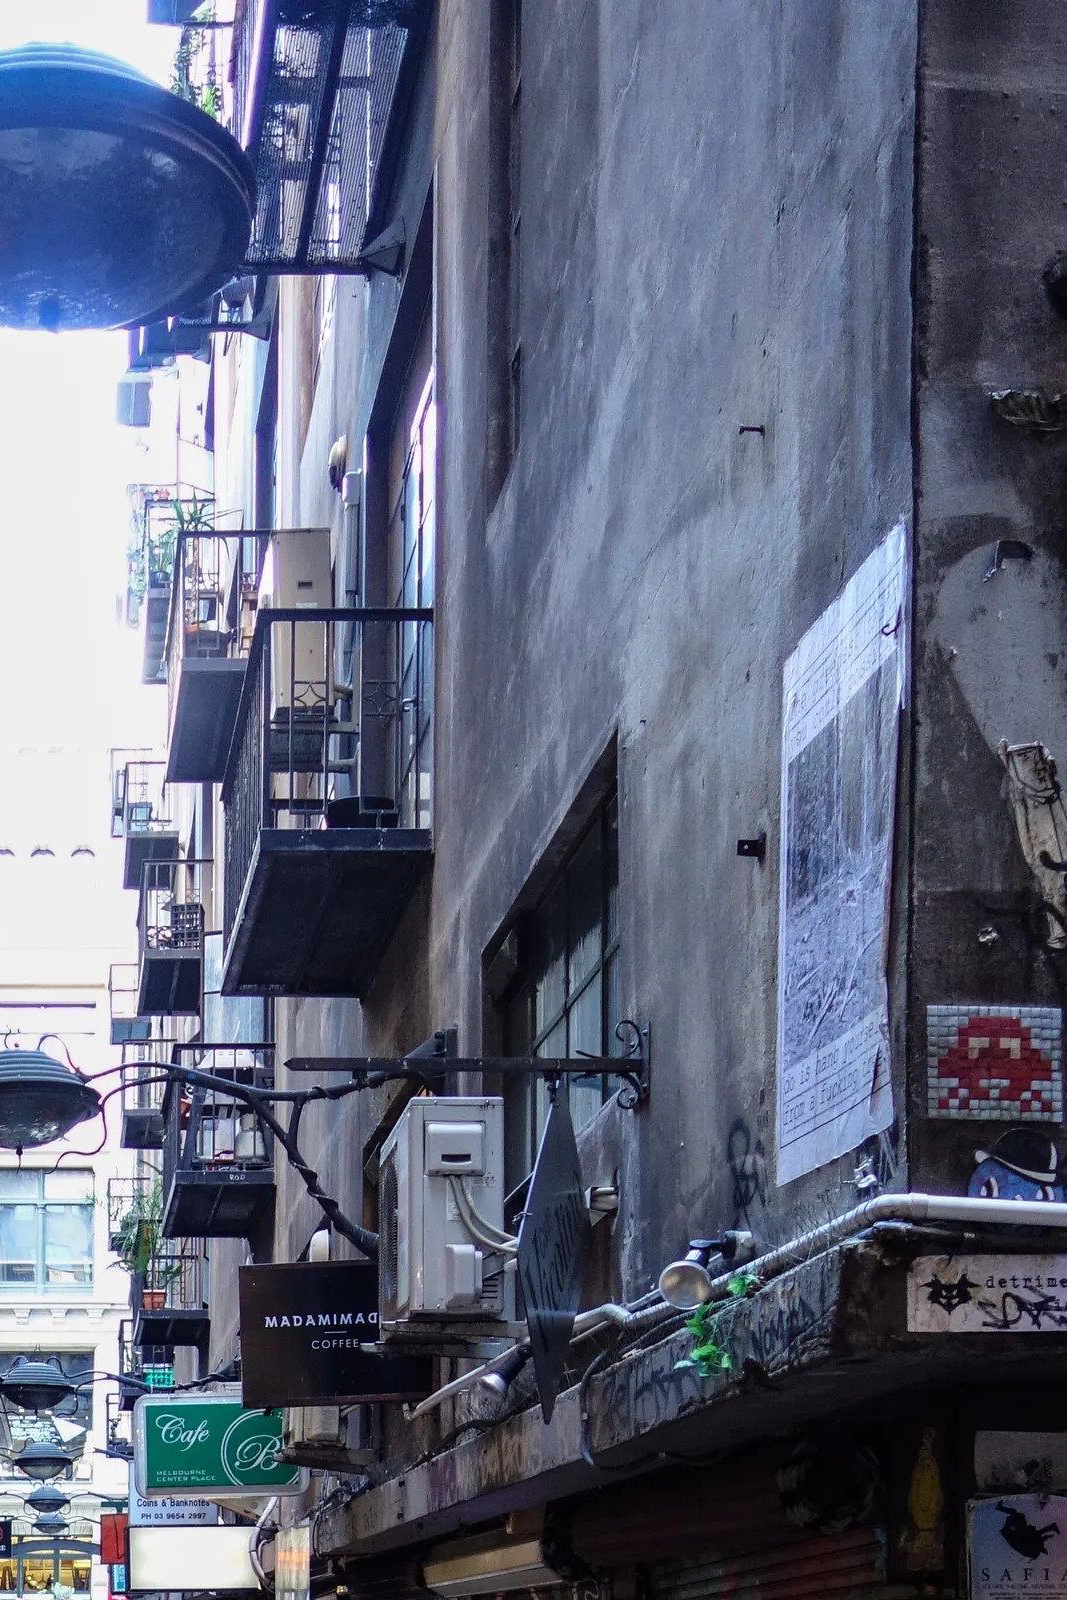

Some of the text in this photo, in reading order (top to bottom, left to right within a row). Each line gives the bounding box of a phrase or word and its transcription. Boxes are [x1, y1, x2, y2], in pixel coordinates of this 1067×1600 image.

[816, 1048, 839, 1077] hang
[820, 1068, 858, 1105] fucking
[311, 1338, 360, 1350] COFFEE
[155, 1413, 210, 1453] Cafe
[156, 1469, 207, 1477] MELBOURNE
[136, 1498, 211, 1508] Coins & Banknotes
[141, 1512, 207, 1520] PH 03 9654 2997
